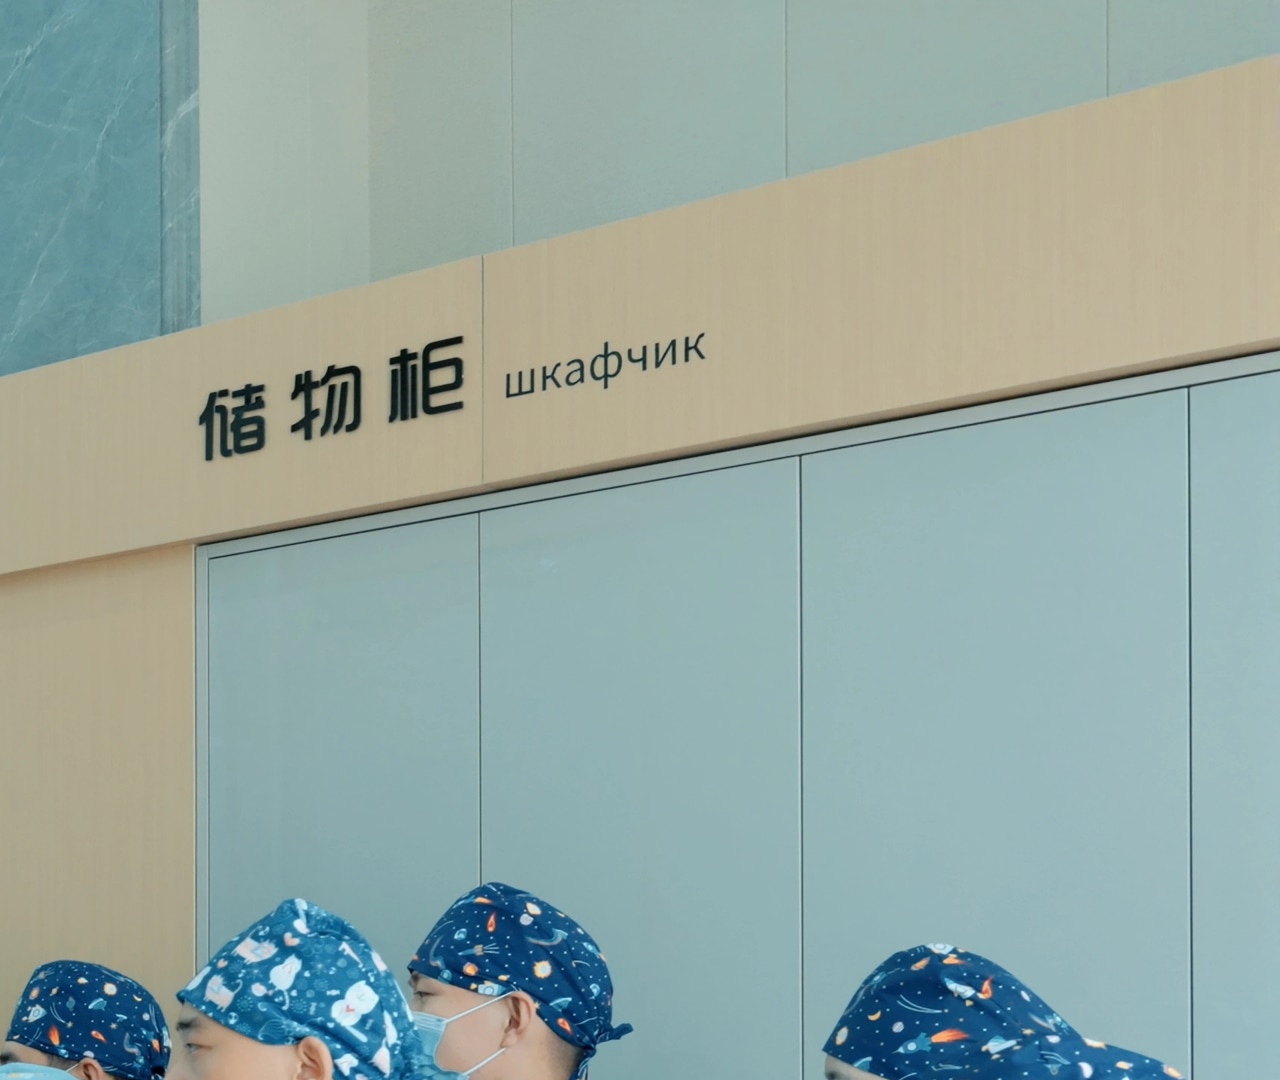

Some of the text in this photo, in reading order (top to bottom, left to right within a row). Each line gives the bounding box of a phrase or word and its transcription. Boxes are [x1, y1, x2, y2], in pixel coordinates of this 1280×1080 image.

[199, 332, 706, 461] 储物柜 шкафчик
